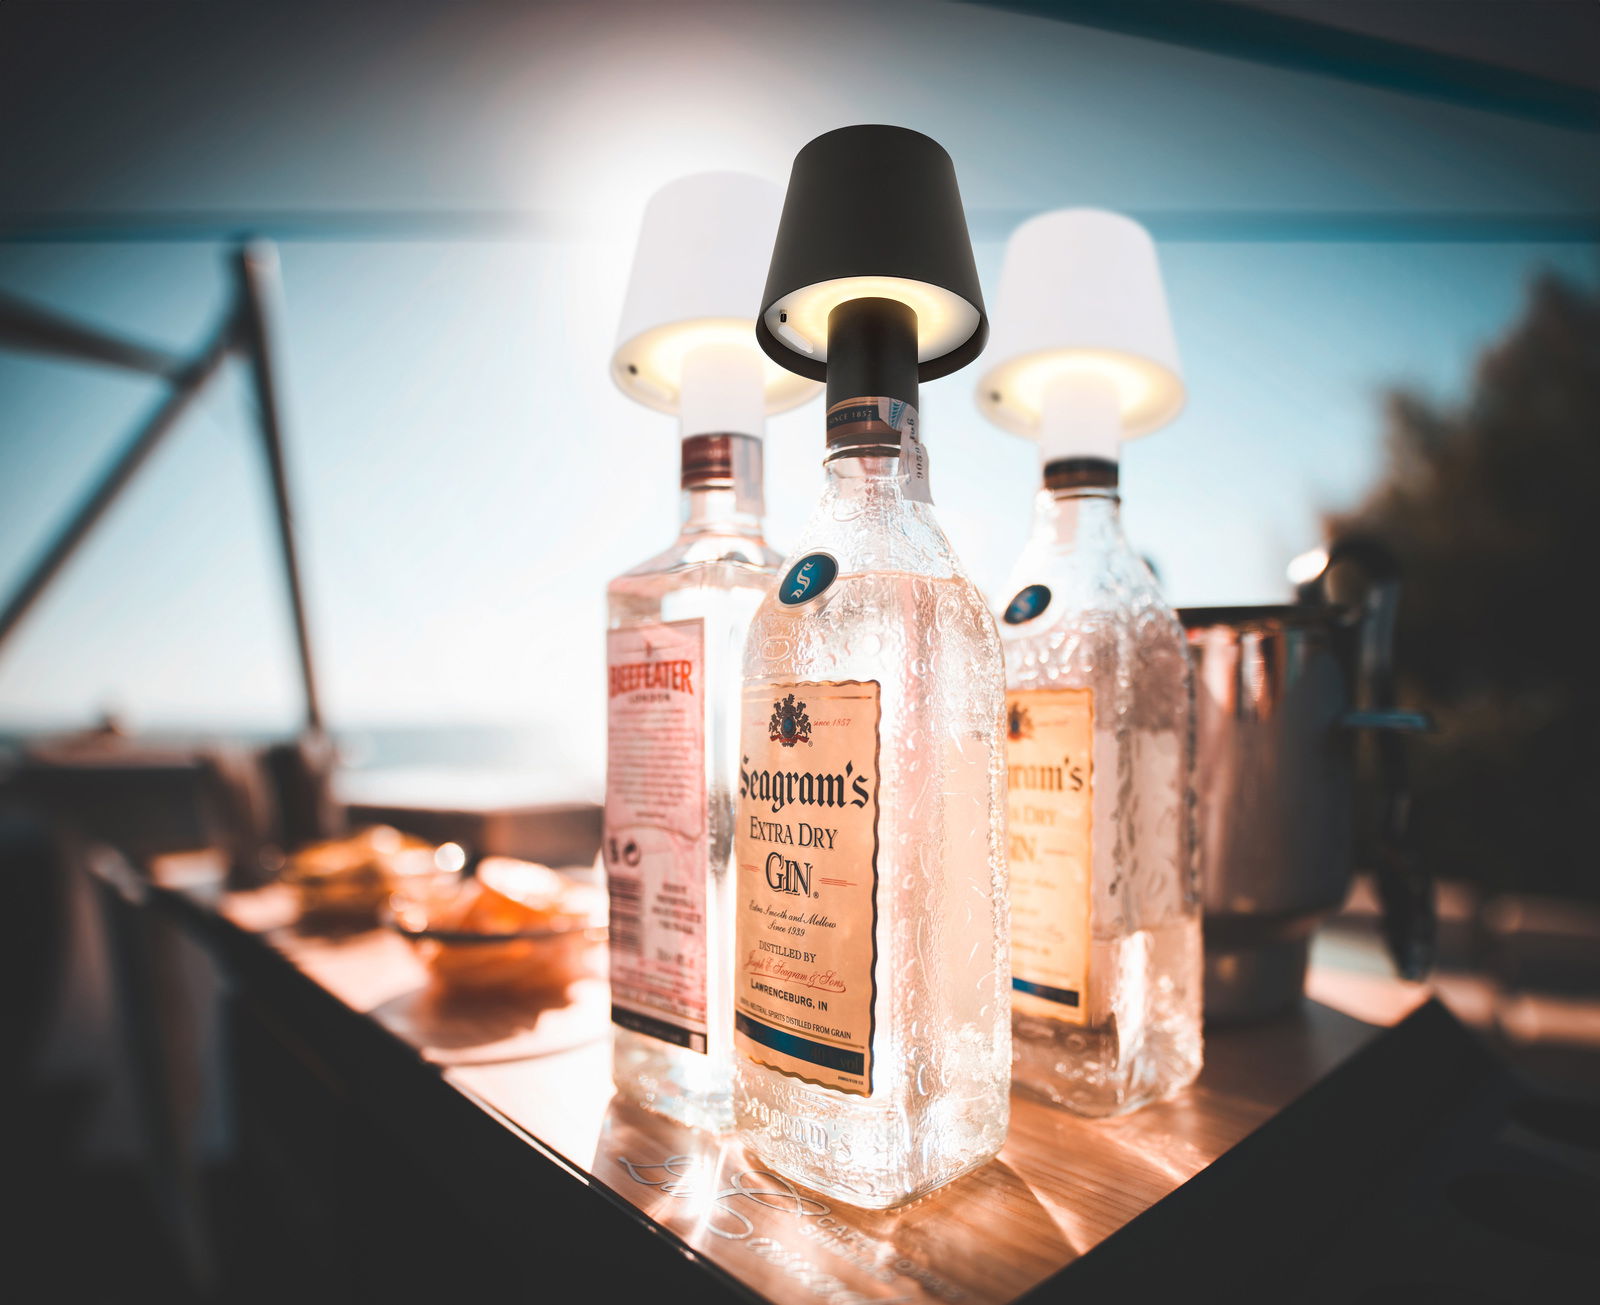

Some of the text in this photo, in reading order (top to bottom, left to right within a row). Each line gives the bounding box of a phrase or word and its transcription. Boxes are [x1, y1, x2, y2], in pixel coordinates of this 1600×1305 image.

[832, 718, 852, 727] 1857
[740, 755, 869, 813] Seagram's
[749, 815, 838, 849] EXTRA DRY
[765, 851, 814, 897] GIN
[763, 904, 787, 919] Smooth
[788, 913, 804, 923] and
[804, 913, 837, 929] Mellow
[768, 919, 806, 936] Since 1939
[759, 939, 817, 963] DISTILLED BY
[773, 960, 807, 982] Seagram
[819, 970, 845, 988] Sons
[817, 1000, 828, 1011] IN
[768, 1010, 785, 1022] SPIRITS
[786, 1016, 812, 1030] DISTILLED
[812, 1021, 830, 1035] FROM
[831, 1028, 851, 1040] GRAIN
